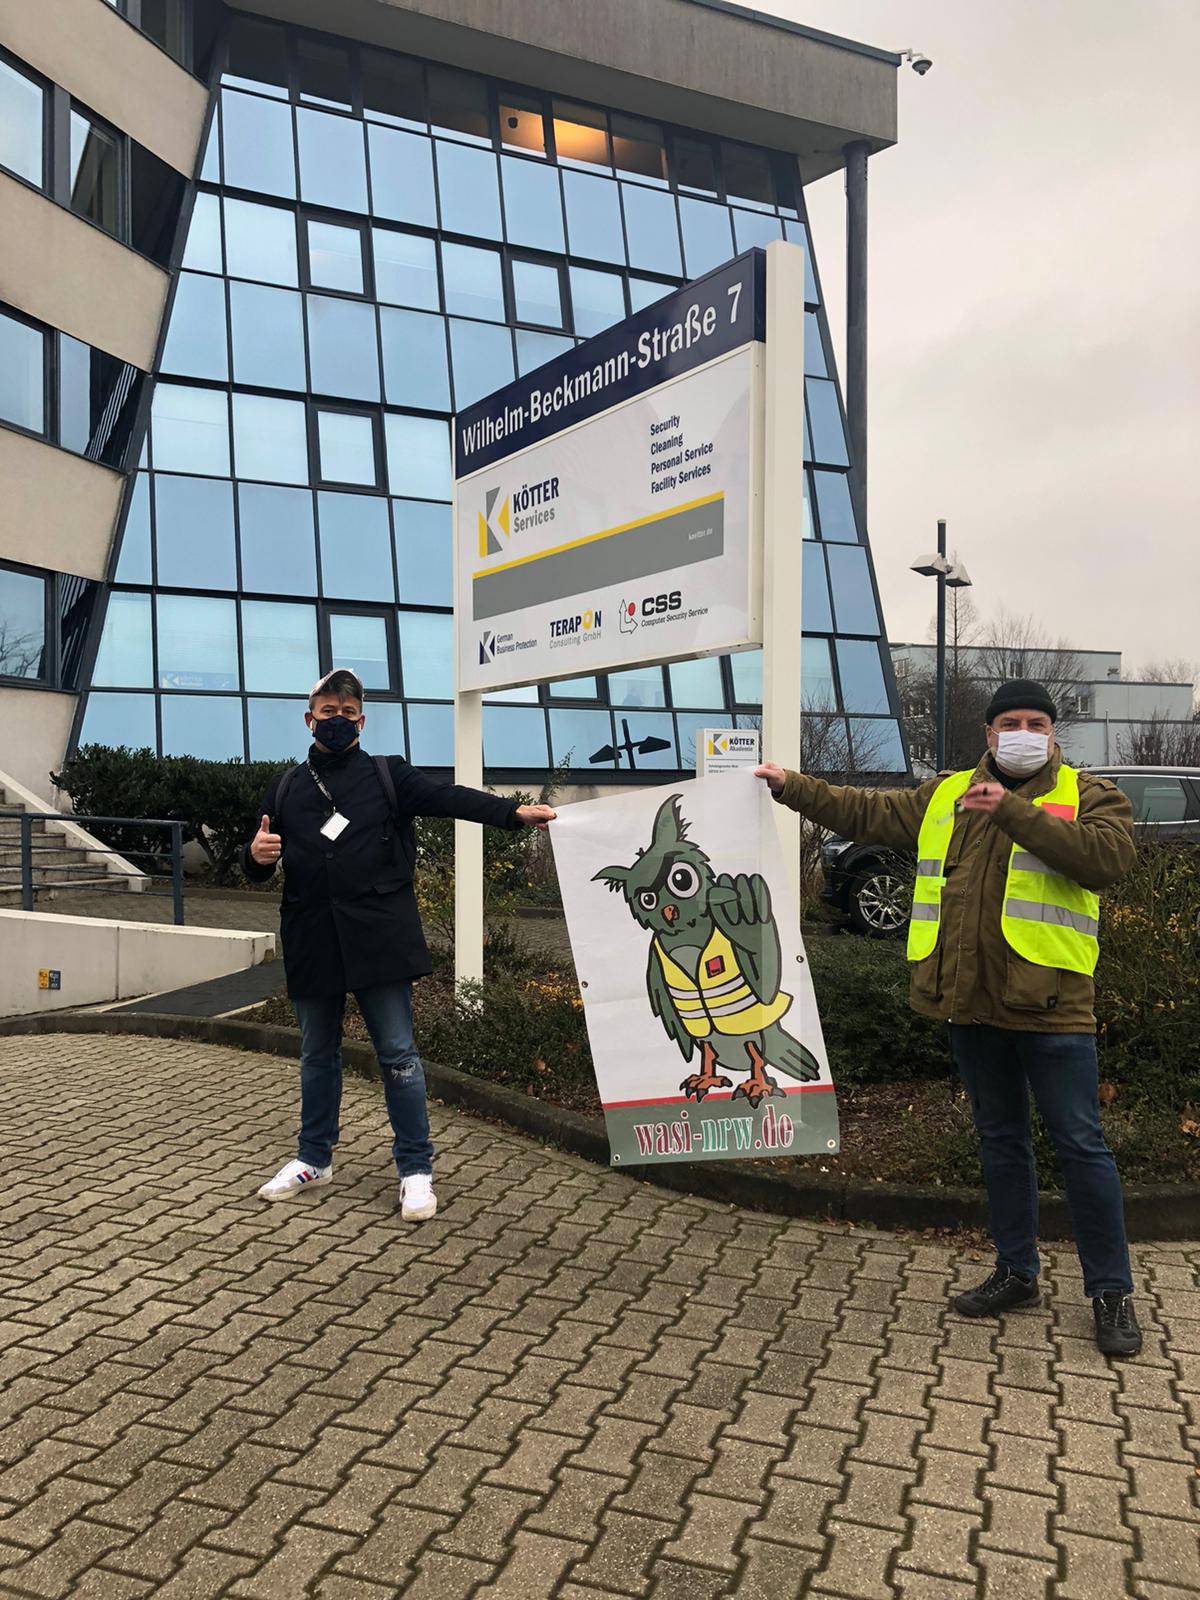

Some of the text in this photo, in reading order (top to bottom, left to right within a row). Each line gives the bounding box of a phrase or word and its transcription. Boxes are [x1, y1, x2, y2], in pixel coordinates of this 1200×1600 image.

[462, 281, 743, 456] Wilhelm-Beckmann-Straße 7
[650, 415, 681, 436] Security
[650, 433, 684, 455] Cleaning
[651, 442, 714, 475] Personal Service
[651, 464, 712, 494] Facility Services
[513, 477, 560, 514] KÖTTER
[513, 507, 556, 533] Services
[641, 590, 682, 617] CSS
[549, 608, 602, 638] TERAPON
[641, 607, 708, 628] Computer Security Service
[496, 632, 513, 644] German
[496, 639, 538, 655] Business Protection
[549, 630, 602, 649] Consulting GmbH
[729, 737, 755, 746] KÖTTER
[633, 1104, 794, 1156] wasi-nrw.de
